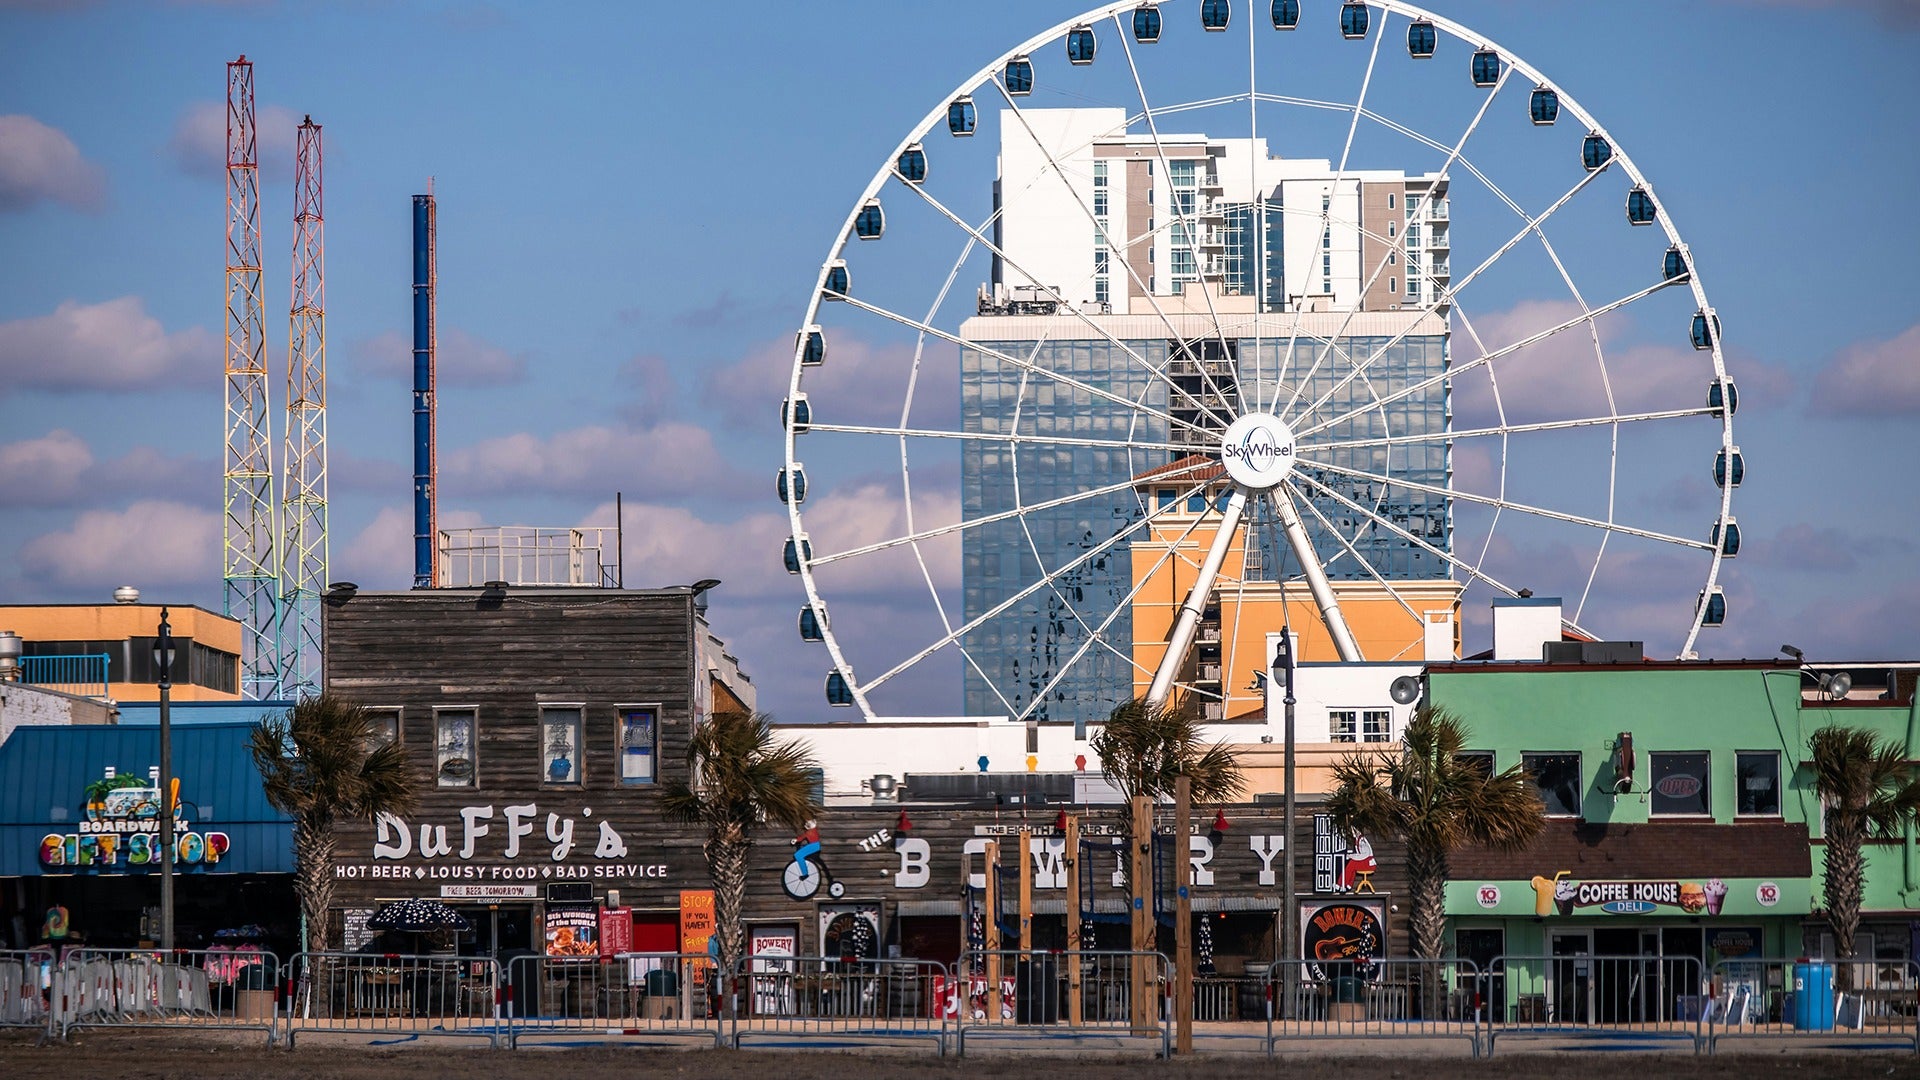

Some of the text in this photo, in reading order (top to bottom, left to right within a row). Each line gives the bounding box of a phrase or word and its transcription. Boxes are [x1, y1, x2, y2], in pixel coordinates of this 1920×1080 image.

[1225, 443, 1293, 461] SkyWheel
[79, 821, 189, 833] BOARDWAK
[985, 825, 1004, 834] THE
[858, 828, 892, 852] THE
[40, 833, 121, 865] GIFT
[336, 865, 668, 879] HOT BEER LOUSY FOOD BAD SERVICE
[465, 886, 482, 896] BEER
[1480, 889, 1497, 901] 10
[1580, 883, 1678, 903] COFFEE HOUSE
[1760, 887, 1776, 898] 10
[683, 895, 713, 908] STOP!
[1617, 902, 1643, 912] DELI
[562, 911, 596, 921] WONDER
[694, 912, 708, 920] YOU
[546, 920, 555, 928] of
[570, 918, 597, 927] WORLD
[756, 938, 792, 954] BOWERY
